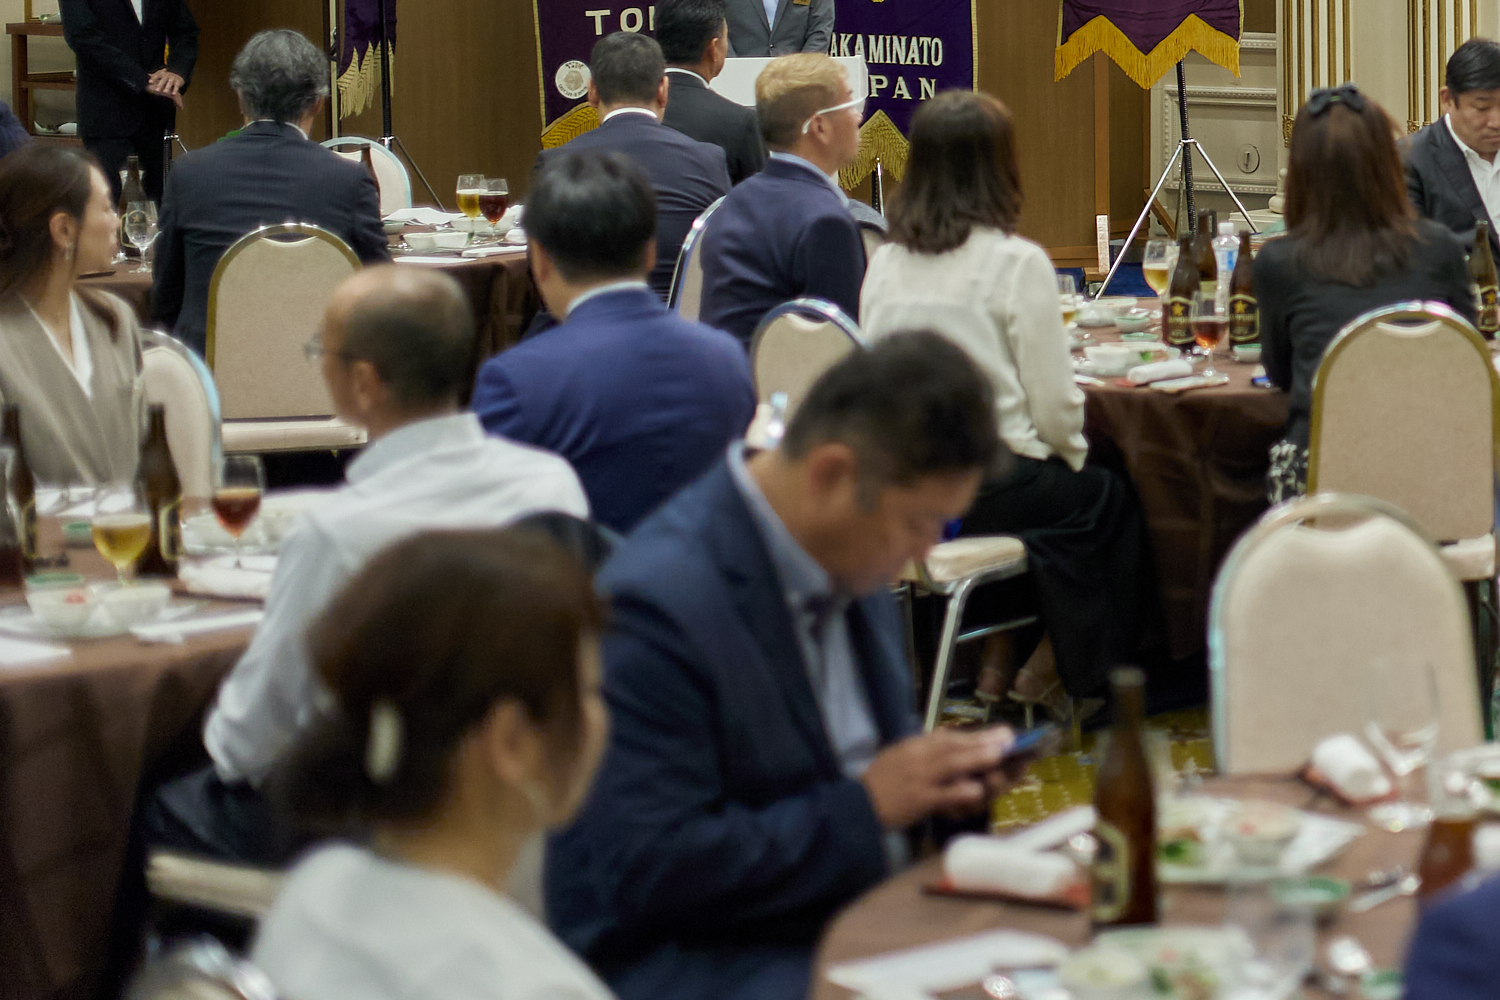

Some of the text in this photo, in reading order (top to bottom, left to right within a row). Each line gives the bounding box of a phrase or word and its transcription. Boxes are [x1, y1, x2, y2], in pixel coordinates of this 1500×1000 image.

[585, 5, 655, 36] TO
[826, 31, 943, 67] AKAMINATO
[868, 74, 936, 101] PAN
